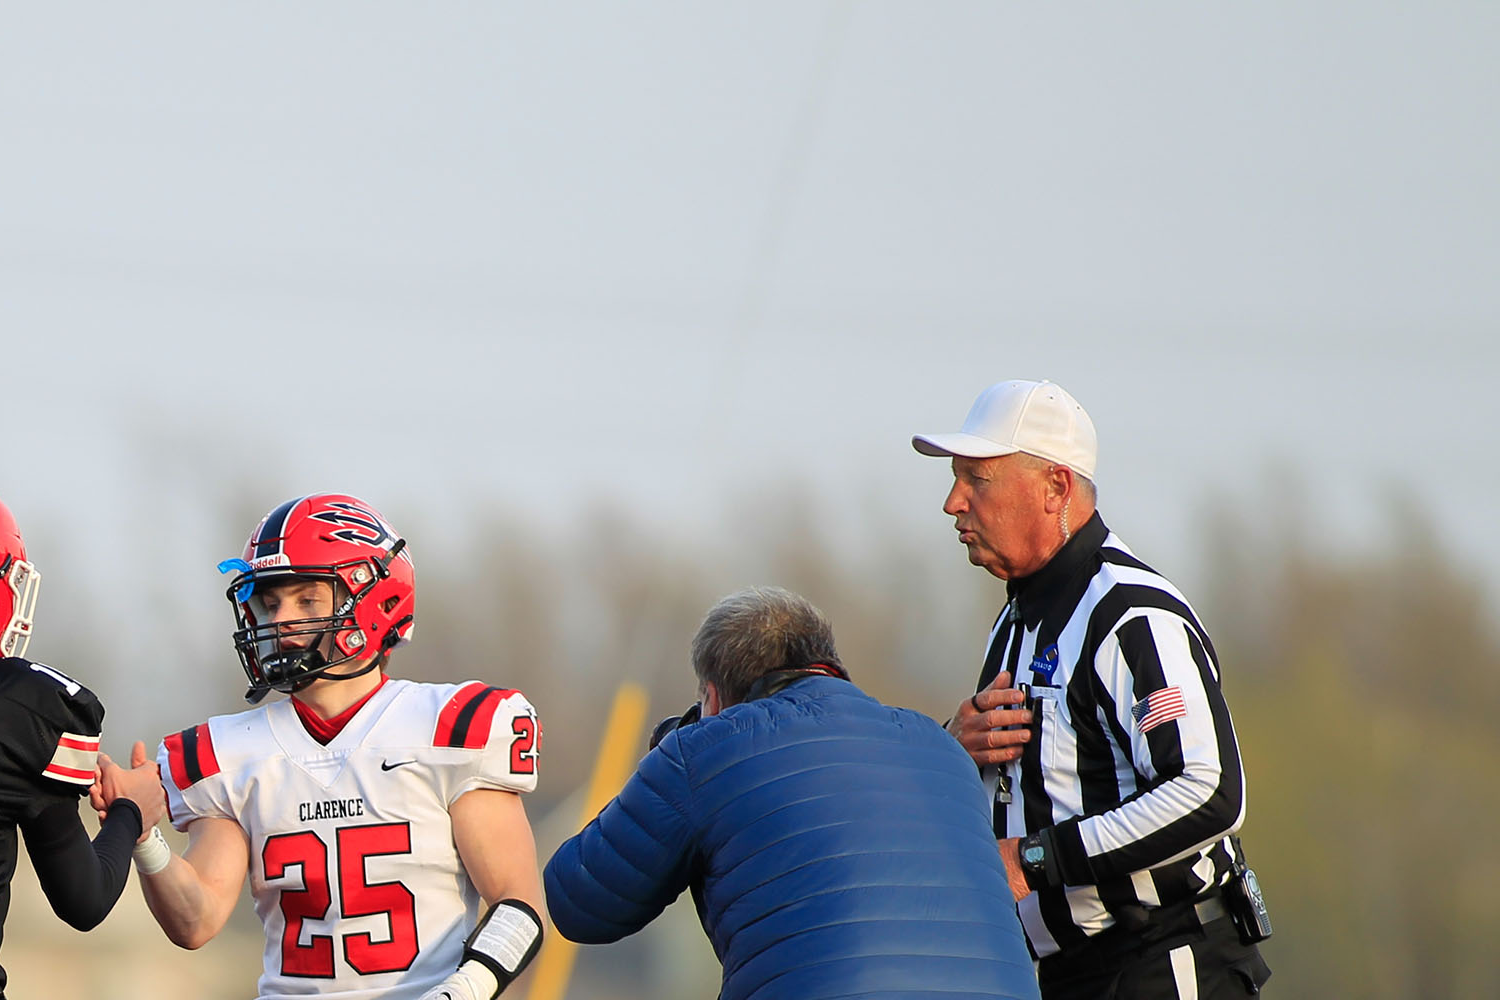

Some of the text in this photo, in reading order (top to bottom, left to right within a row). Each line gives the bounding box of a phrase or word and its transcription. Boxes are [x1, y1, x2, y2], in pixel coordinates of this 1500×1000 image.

[510, 716, 543, 775] 2
[299, 798, 364, 822] CLARENCE
[262, 821, 419, 979] 25
